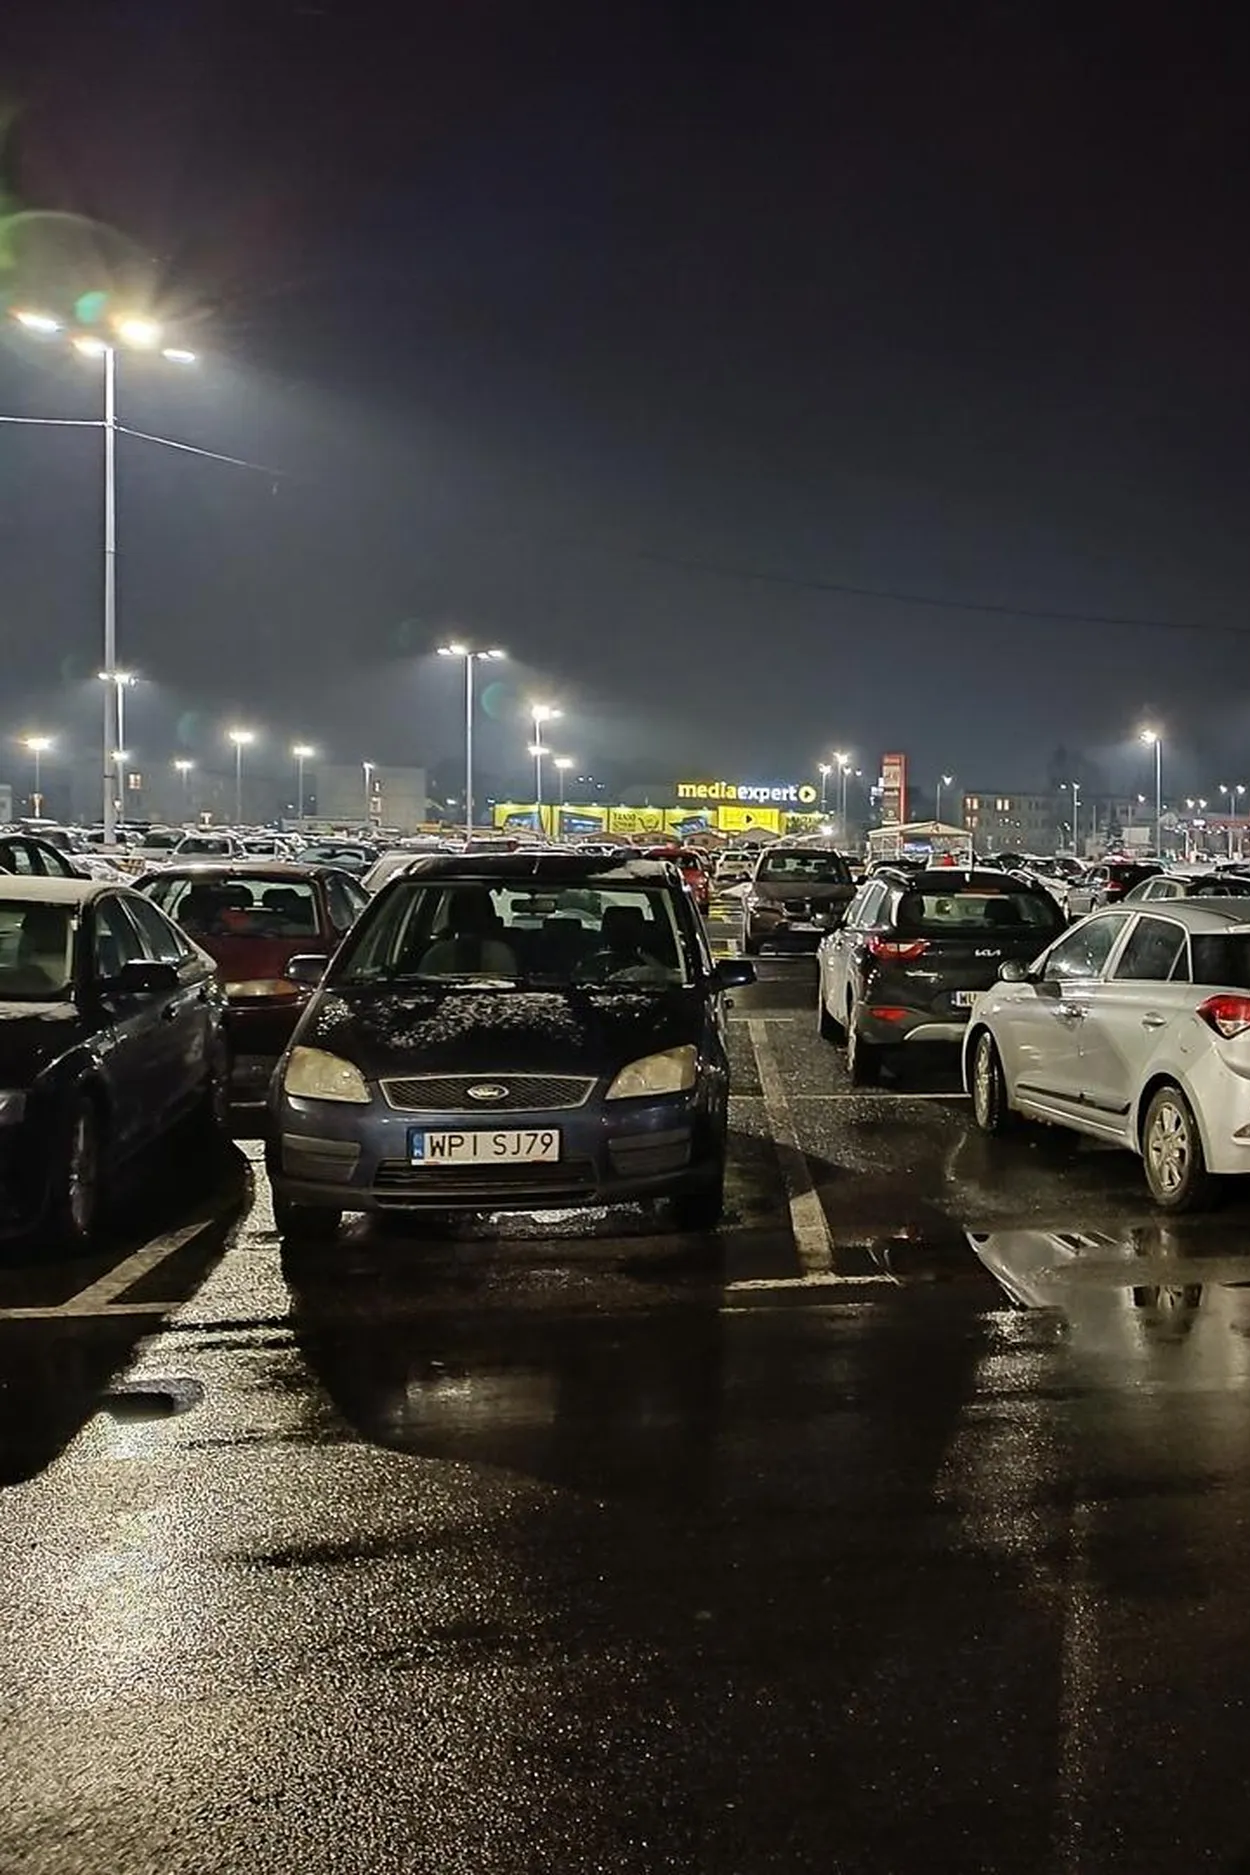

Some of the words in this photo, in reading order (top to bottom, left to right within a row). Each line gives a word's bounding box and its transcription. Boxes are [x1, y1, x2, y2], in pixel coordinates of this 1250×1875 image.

[677, 782, 798, 802] mediaexpert
[429, 1134, 478, 1157] WPI
[492, 1132, 554, 1156] SJ79
